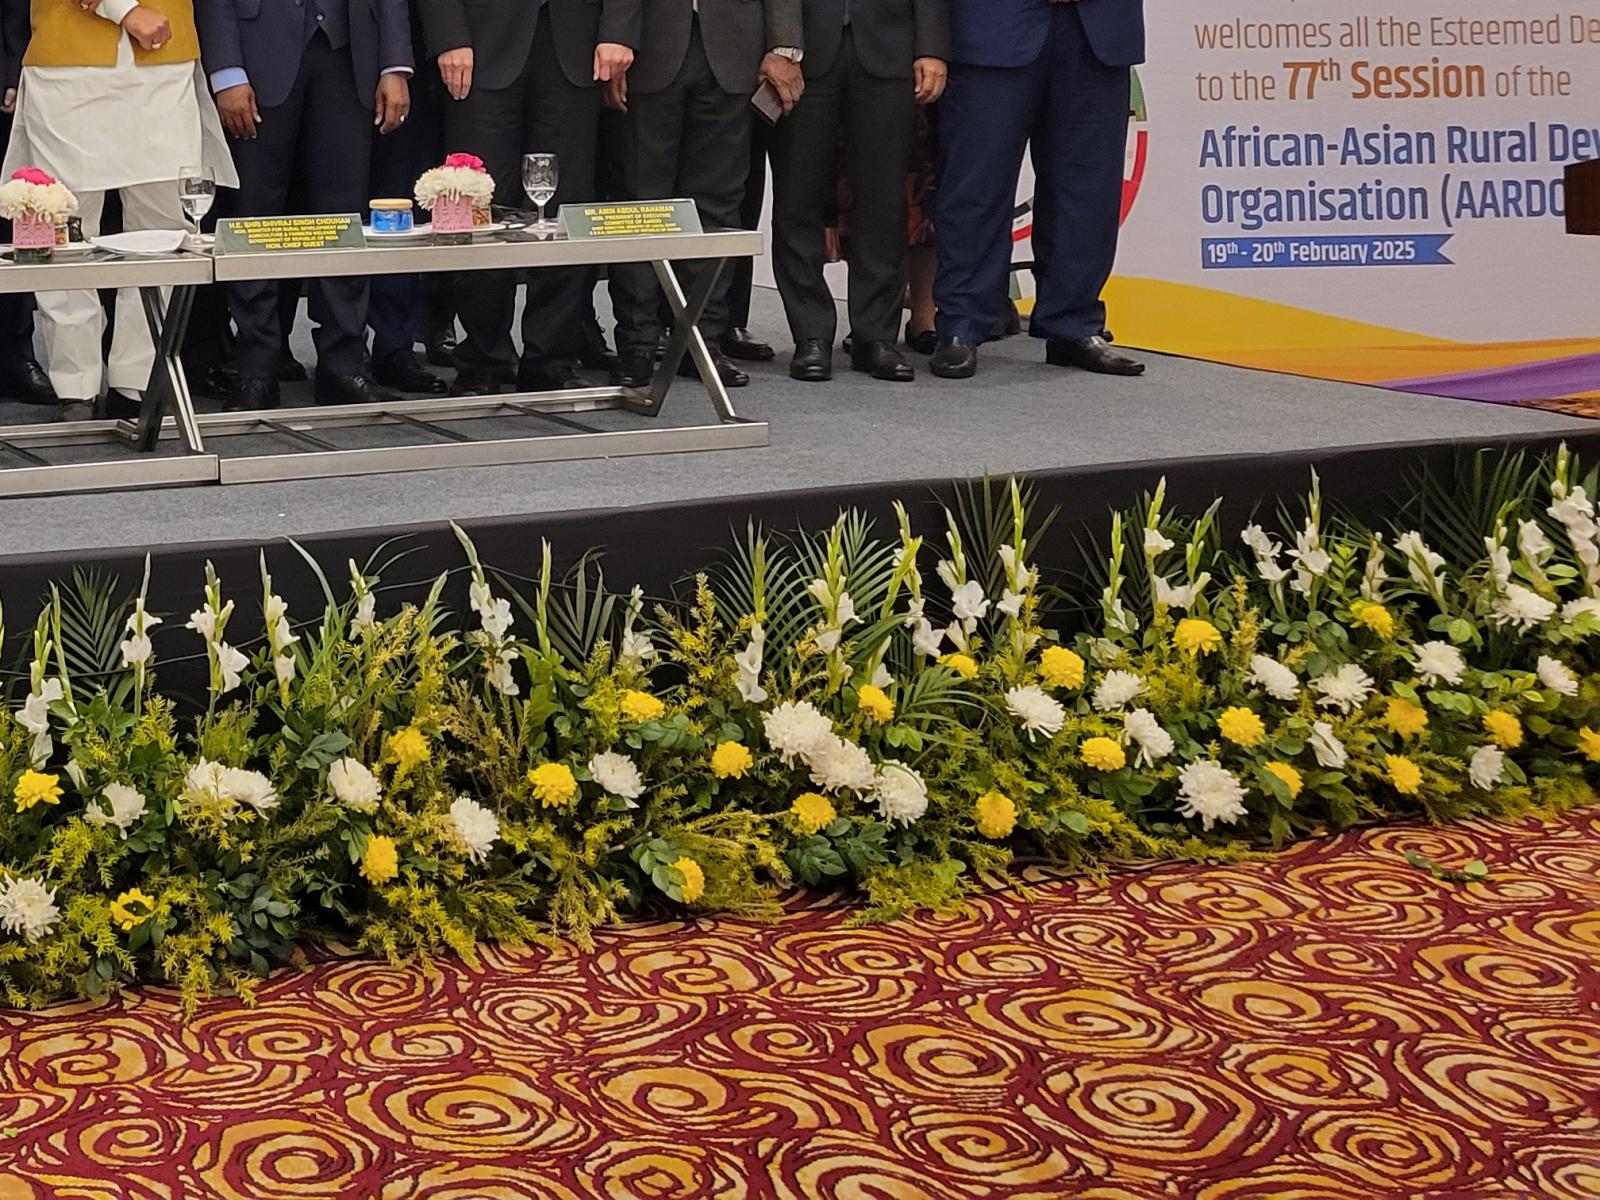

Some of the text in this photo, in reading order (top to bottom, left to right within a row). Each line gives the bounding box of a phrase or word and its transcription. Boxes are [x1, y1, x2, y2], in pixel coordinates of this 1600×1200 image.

[1194, 18, 1332, 49] welcomes
[1339, 16, 1369, 48] all
[1377, 16, 1421, 47] the
[1430, 14, 1560, 46] Esteemed
[1196, 57, 1571, 102] to the 77th Session of the
[1199, 124, 1435, 168] African-Asian
[1447, 121, 1536, 164] Rural
[1201, 180, 1428, 230] Organisation
[1208, 242, 1238, 263] 19th
[1252, 241, 1285, 263] 20th
[1290, 241, 1368, 264] February
[1372, 241, 1415, 261] 2025
